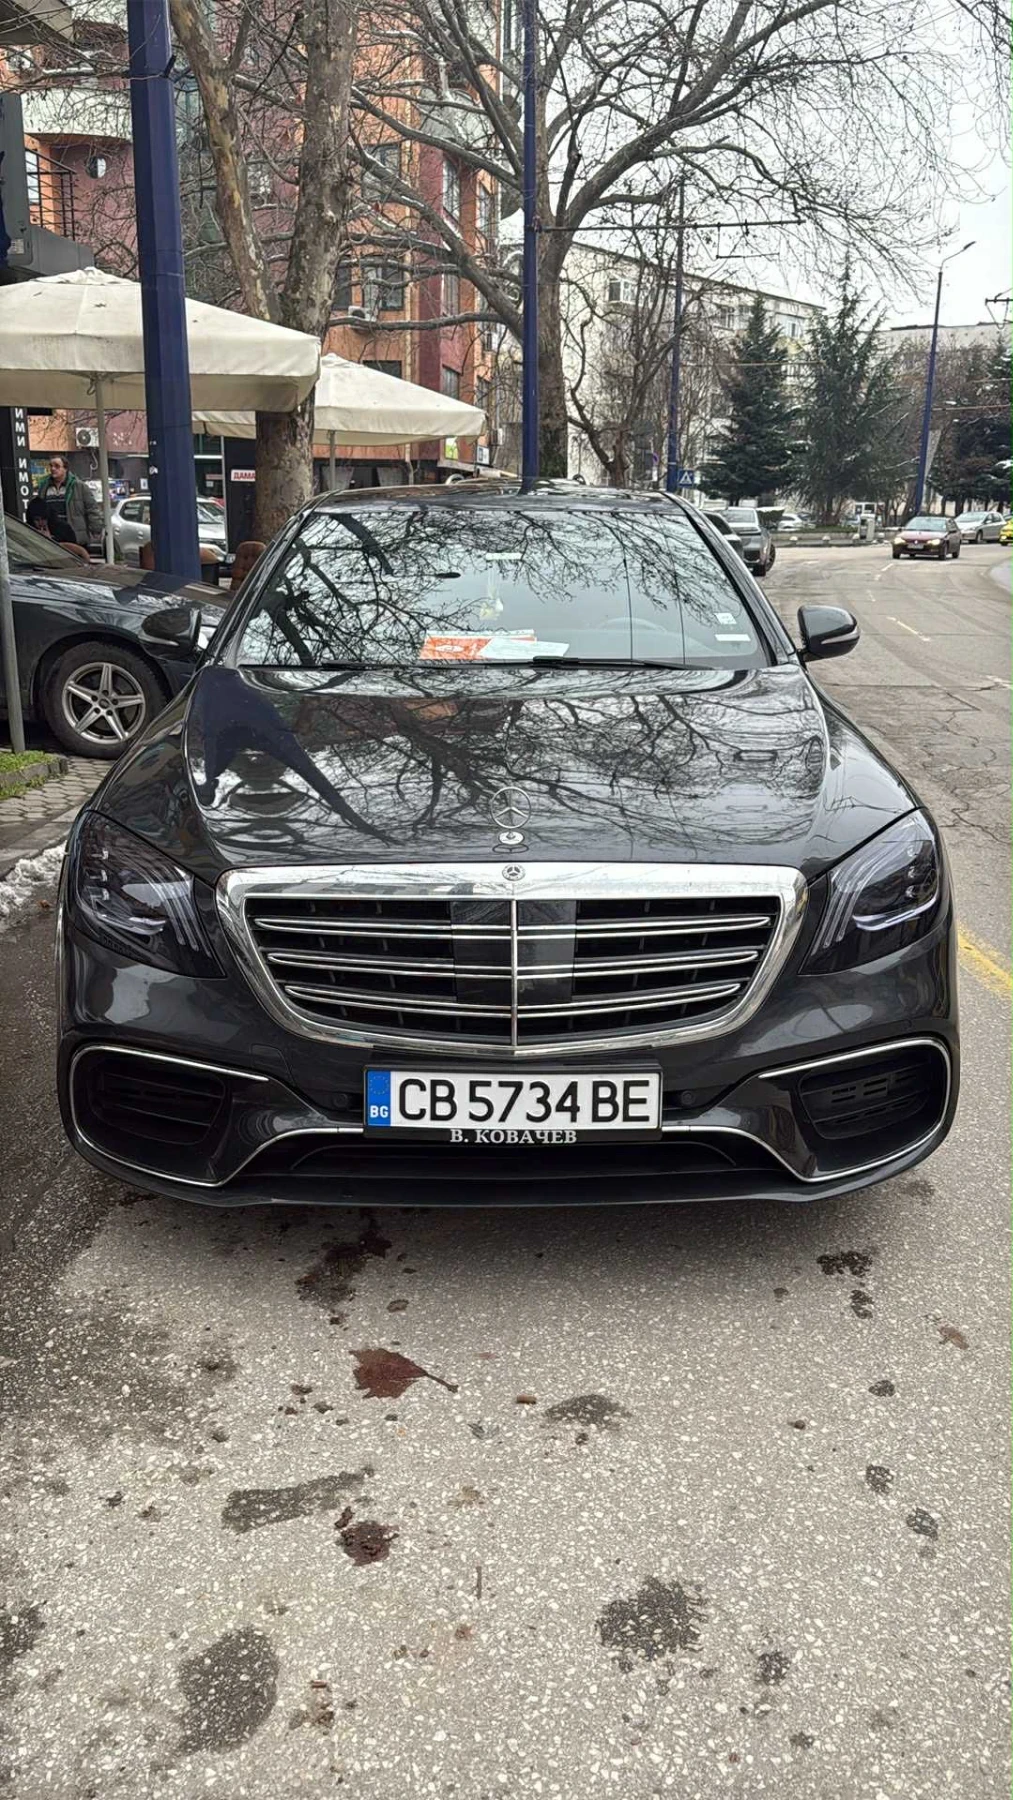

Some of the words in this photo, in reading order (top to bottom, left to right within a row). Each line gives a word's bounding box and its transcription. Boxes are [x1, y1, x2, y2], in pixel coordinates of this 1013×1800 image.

[399, 1078, 458, 1121] CB
[468, 1080, 580, 1123] 5734
[592, 1080, 650, 1122] BE
[370, 1106, 389, 1119] BG
[450, 1129, 469, 1143] В.
[475, 1130, 577, 1144] КОВАЧЕВ
